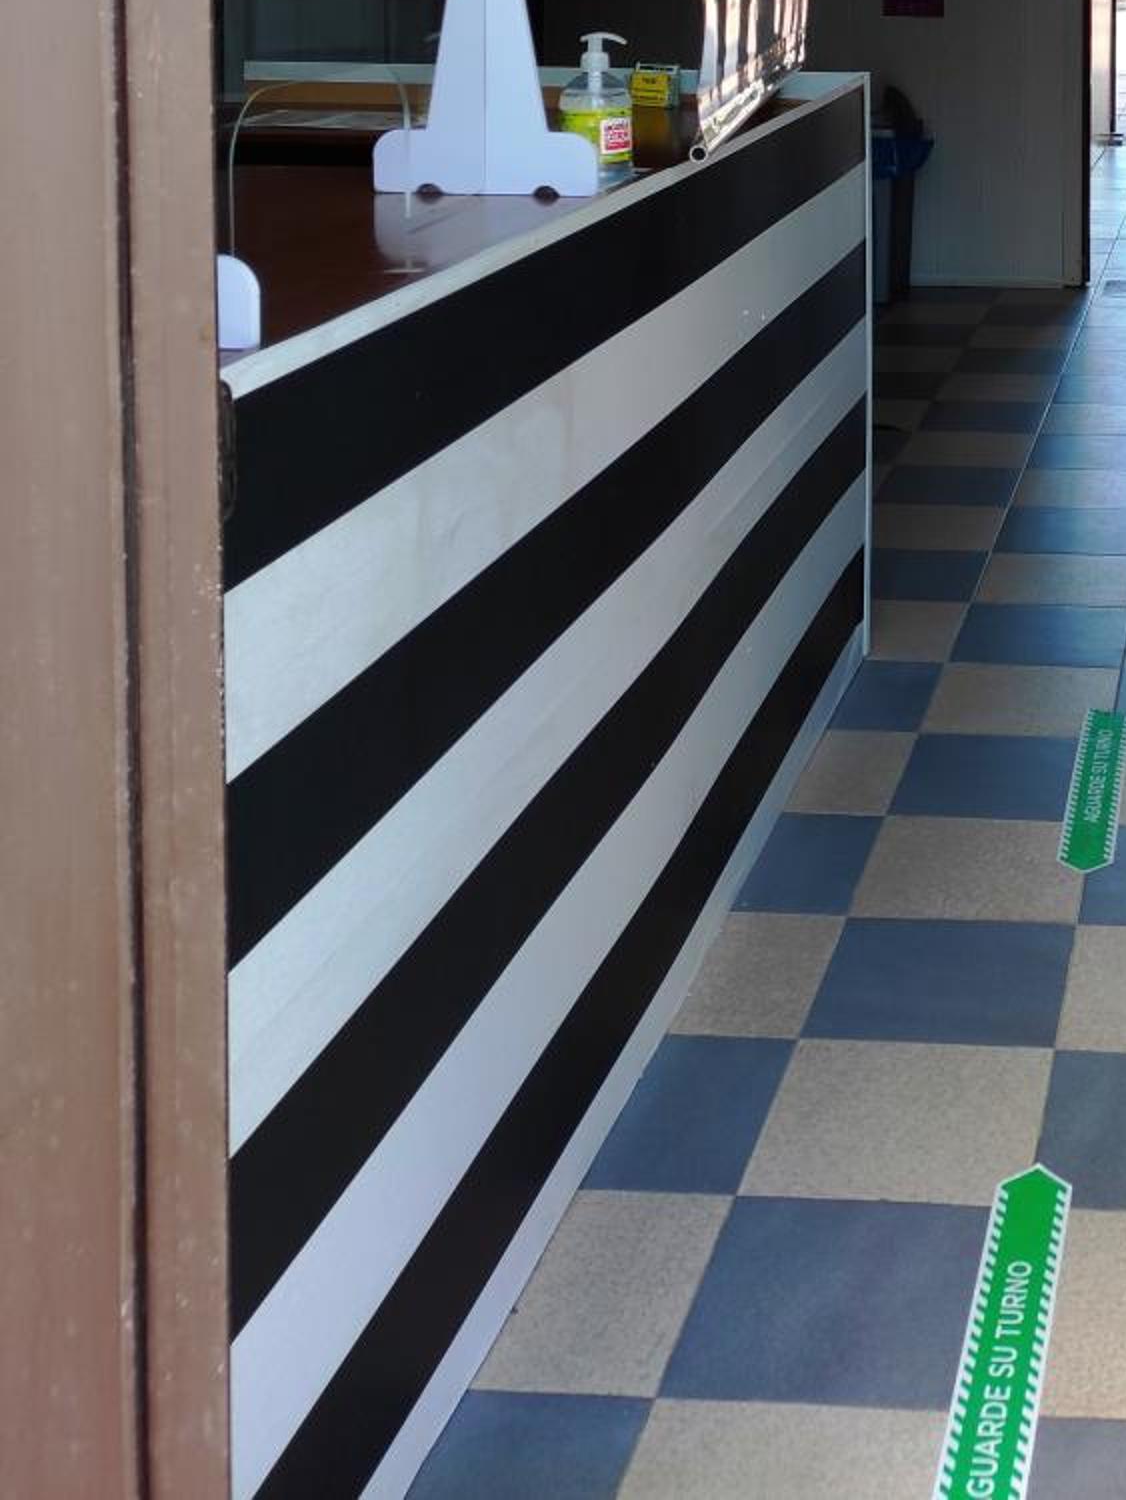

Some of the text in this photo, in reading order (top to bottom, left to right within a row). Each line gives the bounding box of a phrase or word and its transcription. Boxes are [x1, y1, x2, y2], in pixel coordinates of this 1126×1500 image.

[1083, 775, 1107, 823] AGUARDE
[995, 1260, 1033, 1339] TURNO
[988, 1347, 1019, 1378] SU
